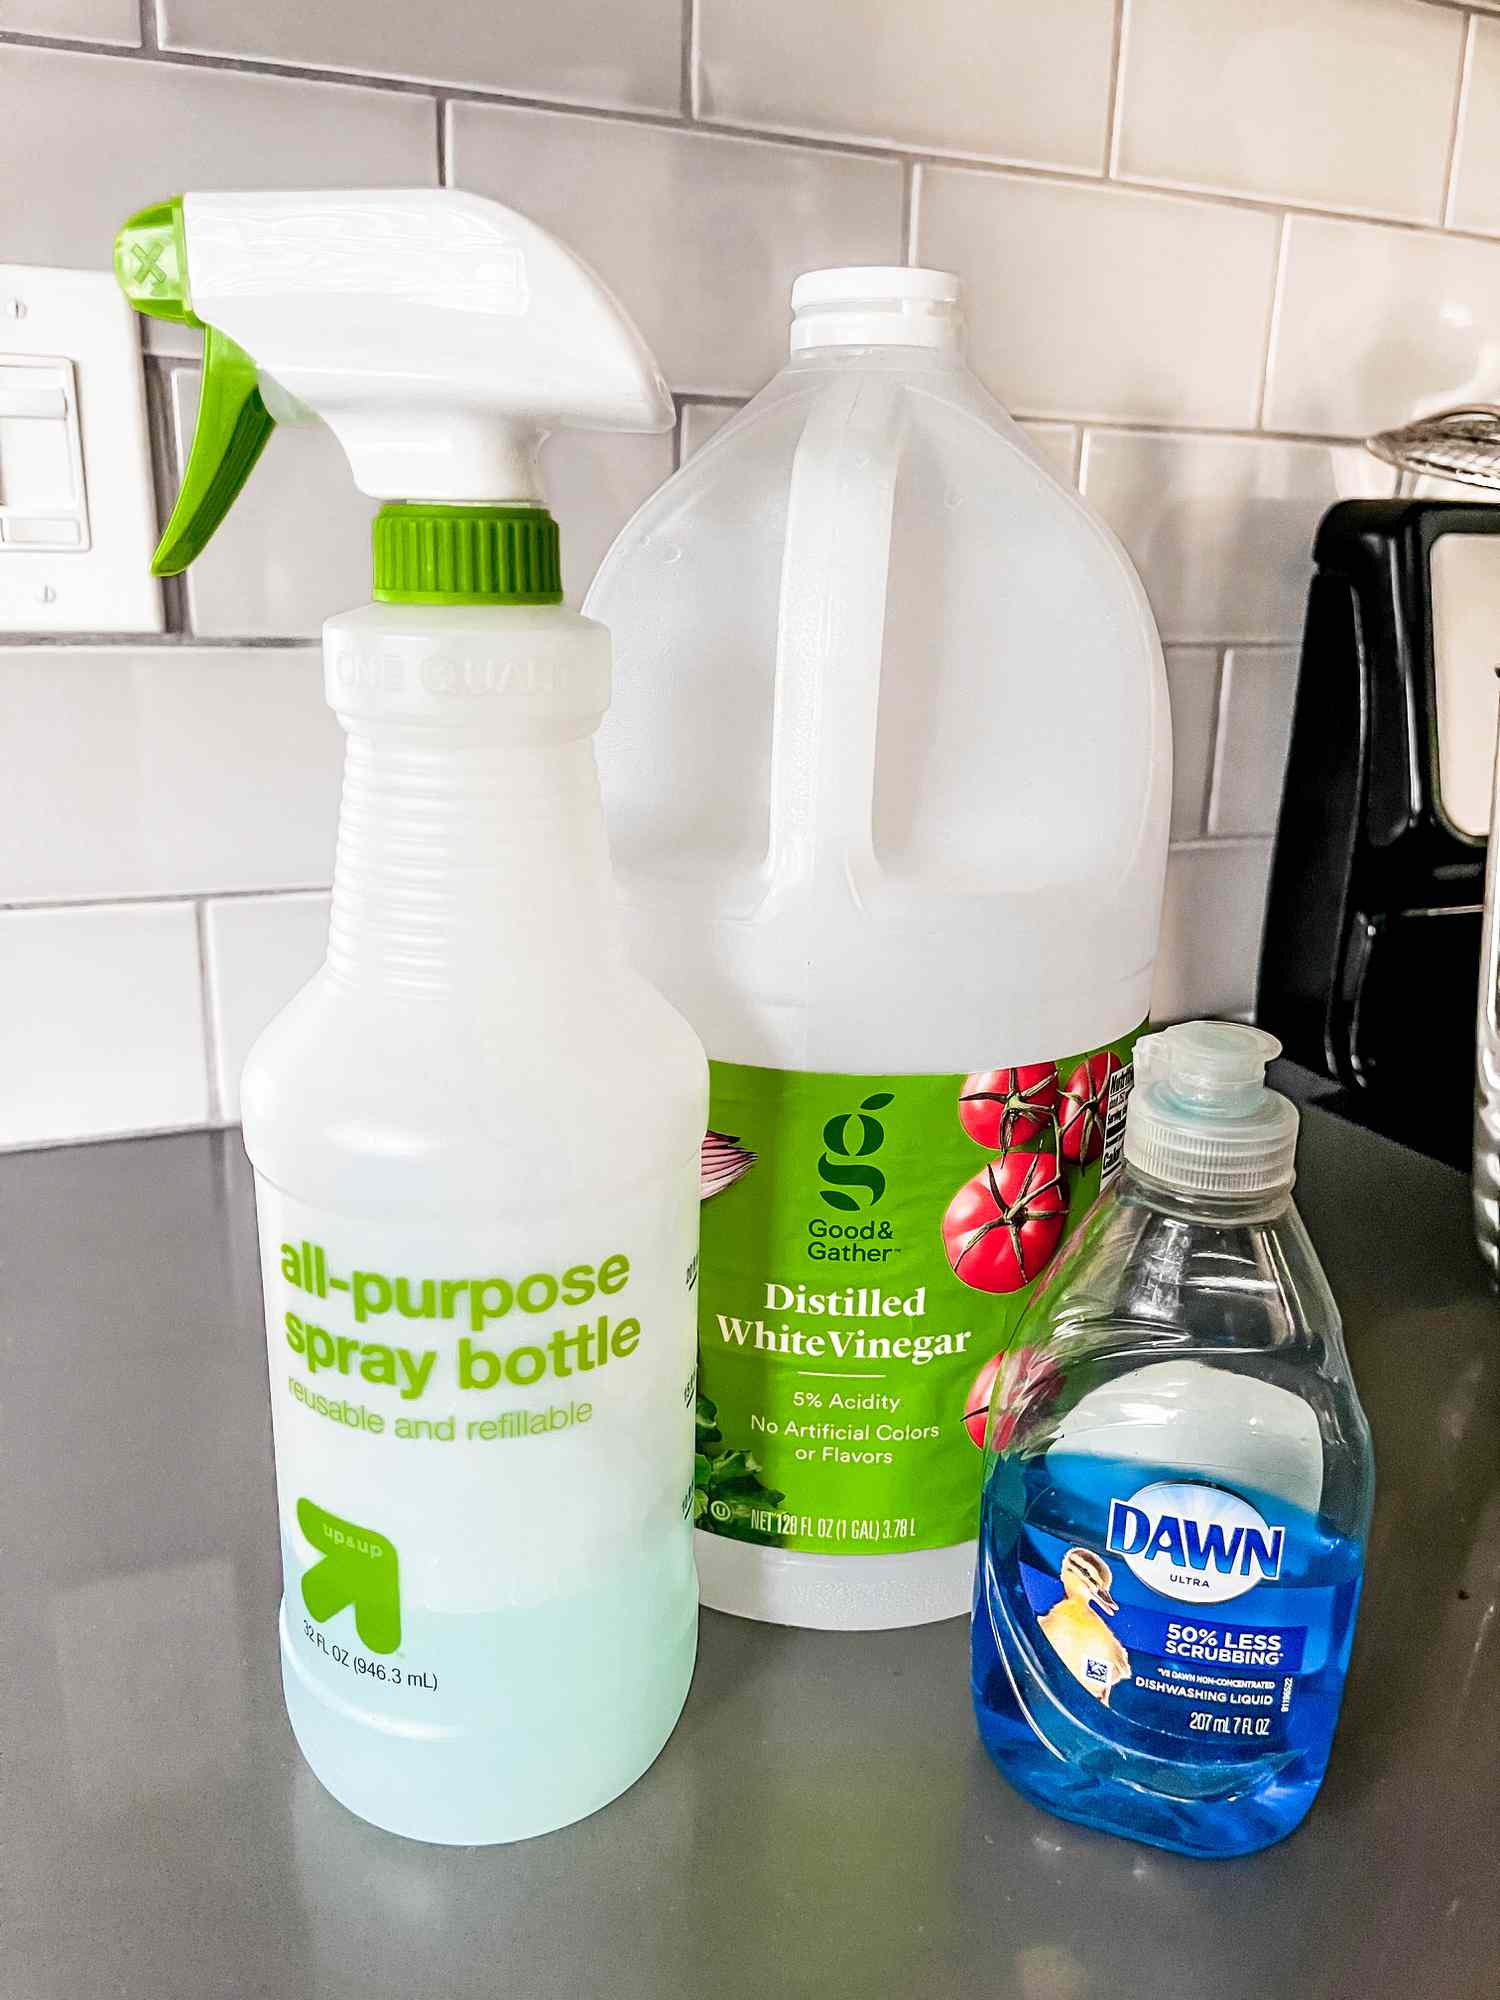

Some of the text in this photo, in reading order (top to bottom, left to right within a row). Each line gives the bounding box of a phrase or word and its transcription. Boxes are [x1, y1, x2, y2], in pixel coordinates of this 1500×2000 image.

[280, 1240, 631, 1331] all-purpose
[764, 1283, 926, 1317] Distilled
[285, 1311, 437, 1400] spray
[457, 1315, 641, 1390] bottle
[716, 1314, 972, 1365] White Vinegar
[288, 1375, 593, 1442] reusable and refillable
[793, 1391, 901, 1413] 5% Acidity
[751, 1414, 940, 1441] No Artificial Colors
[795, 1446, 893, 1464] or Flavors
[322, 1523, 384, 1559] up&up
[751, 1509, 772, 1532] NET
[776, 1513, 798, 1536] 128
[801, 1516, 814, 1537] FL
[817, 1518, 834, 1538] OZ
[851, 1519, 880, 1541] GAL)
[883, 1518, 908, 1538] 3.78
[910, 1518, 916, 1537] L
[1109, 1502, 1283, 1579] DAWN
[1169, 1573, 1210, 1589] ULTRA
[1167, 1623, 1282, 1650] 50% LESS
[303, 1619, 439, 1691] 32 FL OZ (946.3 mL)
[1135, 1675, 1274, 1706] DISHWASHING LIQUID
[1172, 1671, 1195, 1683] DAWN
[1195, 1674, 1276, 1690] NON-CONCENTRATED
[1189, 1711, 1271, 1736] 207 mL 7 FL OZ
